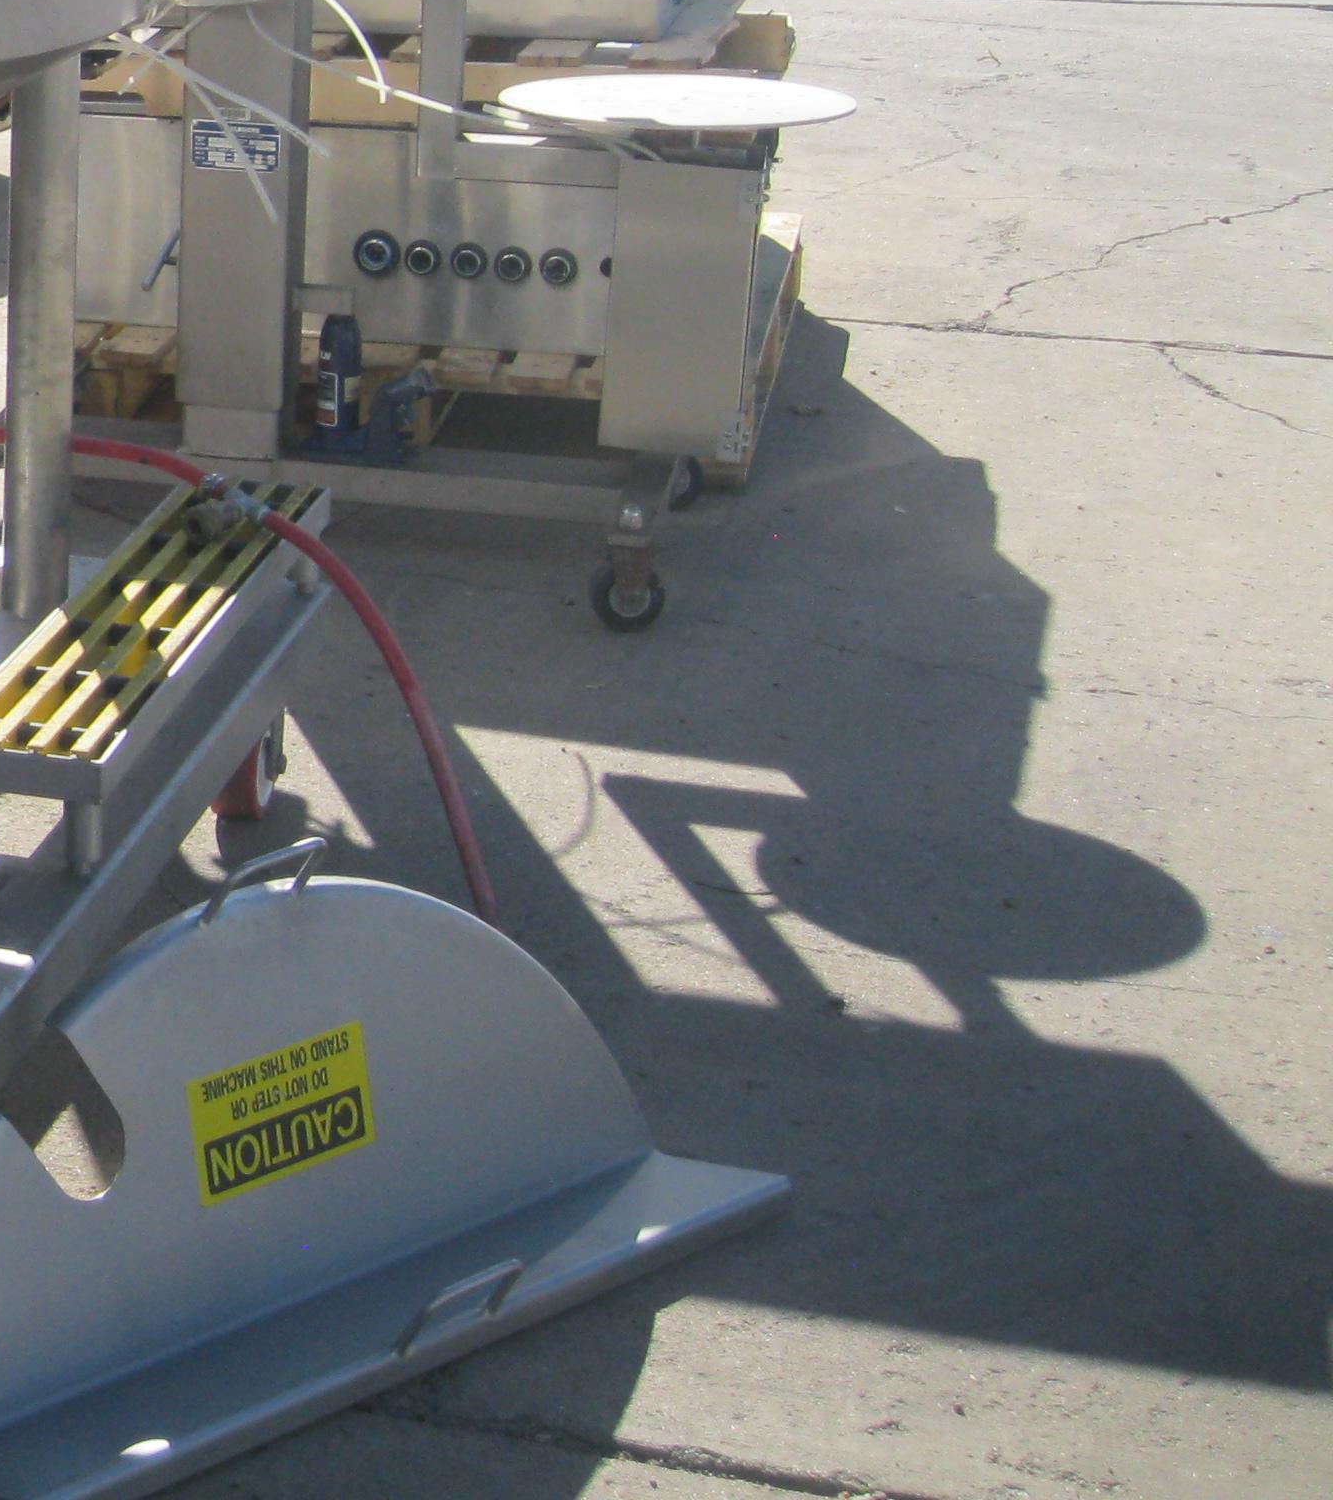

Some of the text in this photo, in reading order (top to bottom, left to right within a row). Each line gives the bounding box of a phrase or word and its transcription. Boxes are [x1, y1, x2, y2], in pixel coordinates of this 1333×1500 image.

[201, 1031, 349, 1103] STAND ON THIS MACHINE
[230, 1067, 329, 1120] DO NOT STEP OR
[209, 1096, 359, 1187] CAUTION
